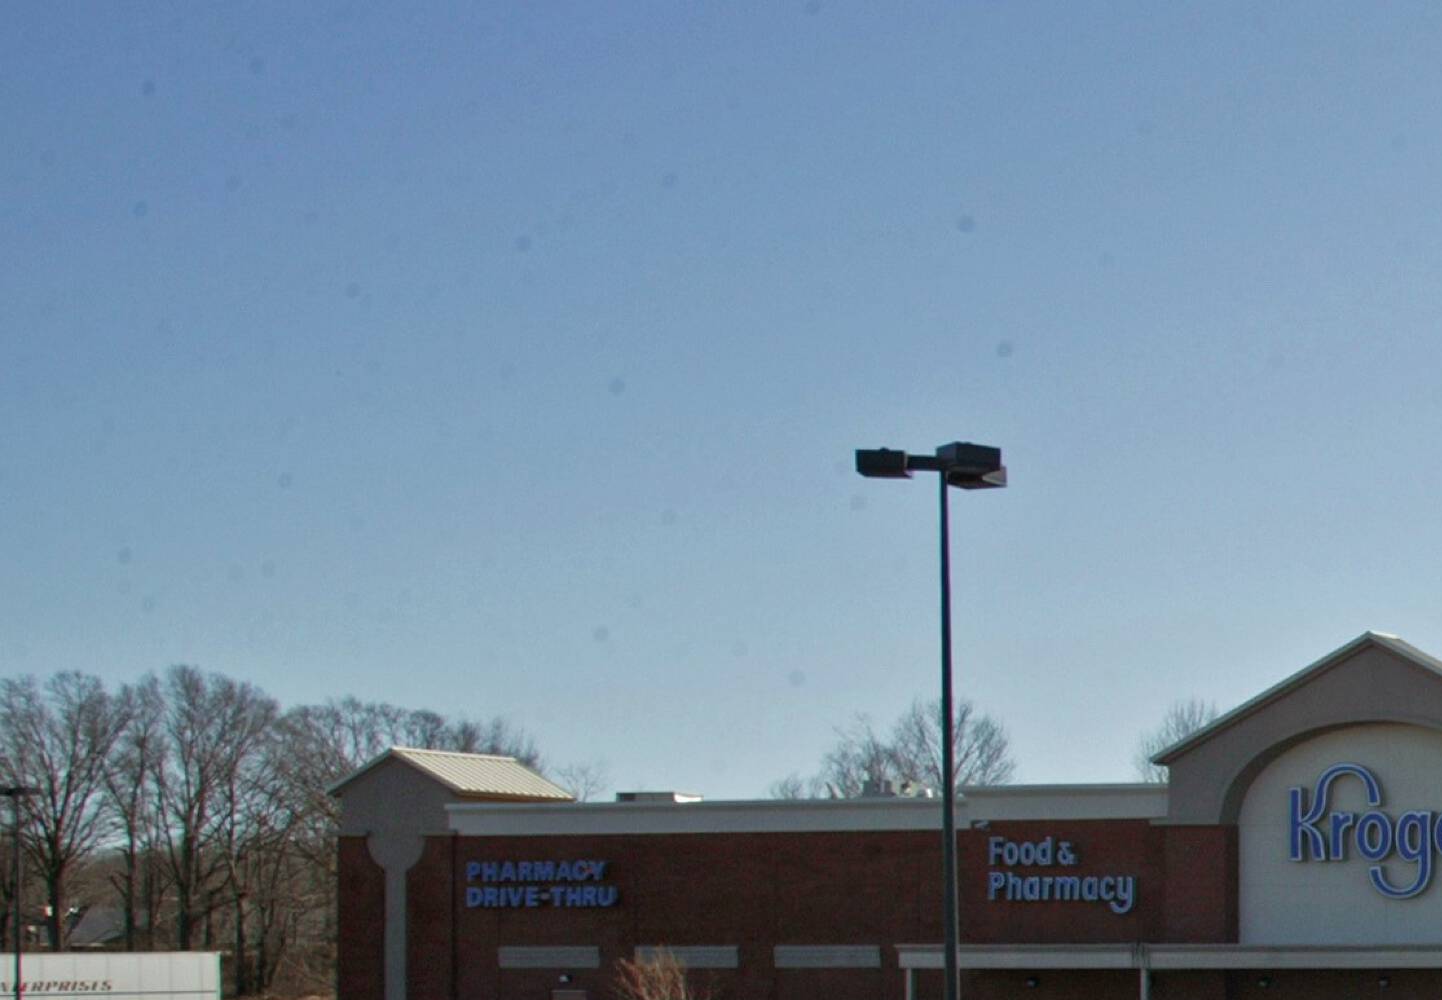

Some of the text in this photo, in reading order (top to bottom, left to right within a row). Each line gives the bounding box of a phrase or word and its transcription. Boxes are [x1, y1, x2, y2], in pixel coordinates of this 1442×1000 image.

[989, 836, 1077, 866] Food &
[465, 860, 607, 882] PHARMACY
[465, 885, 620, 908] DRIVE-THRU
[988, 872, 1135, 914] Pharmacy
